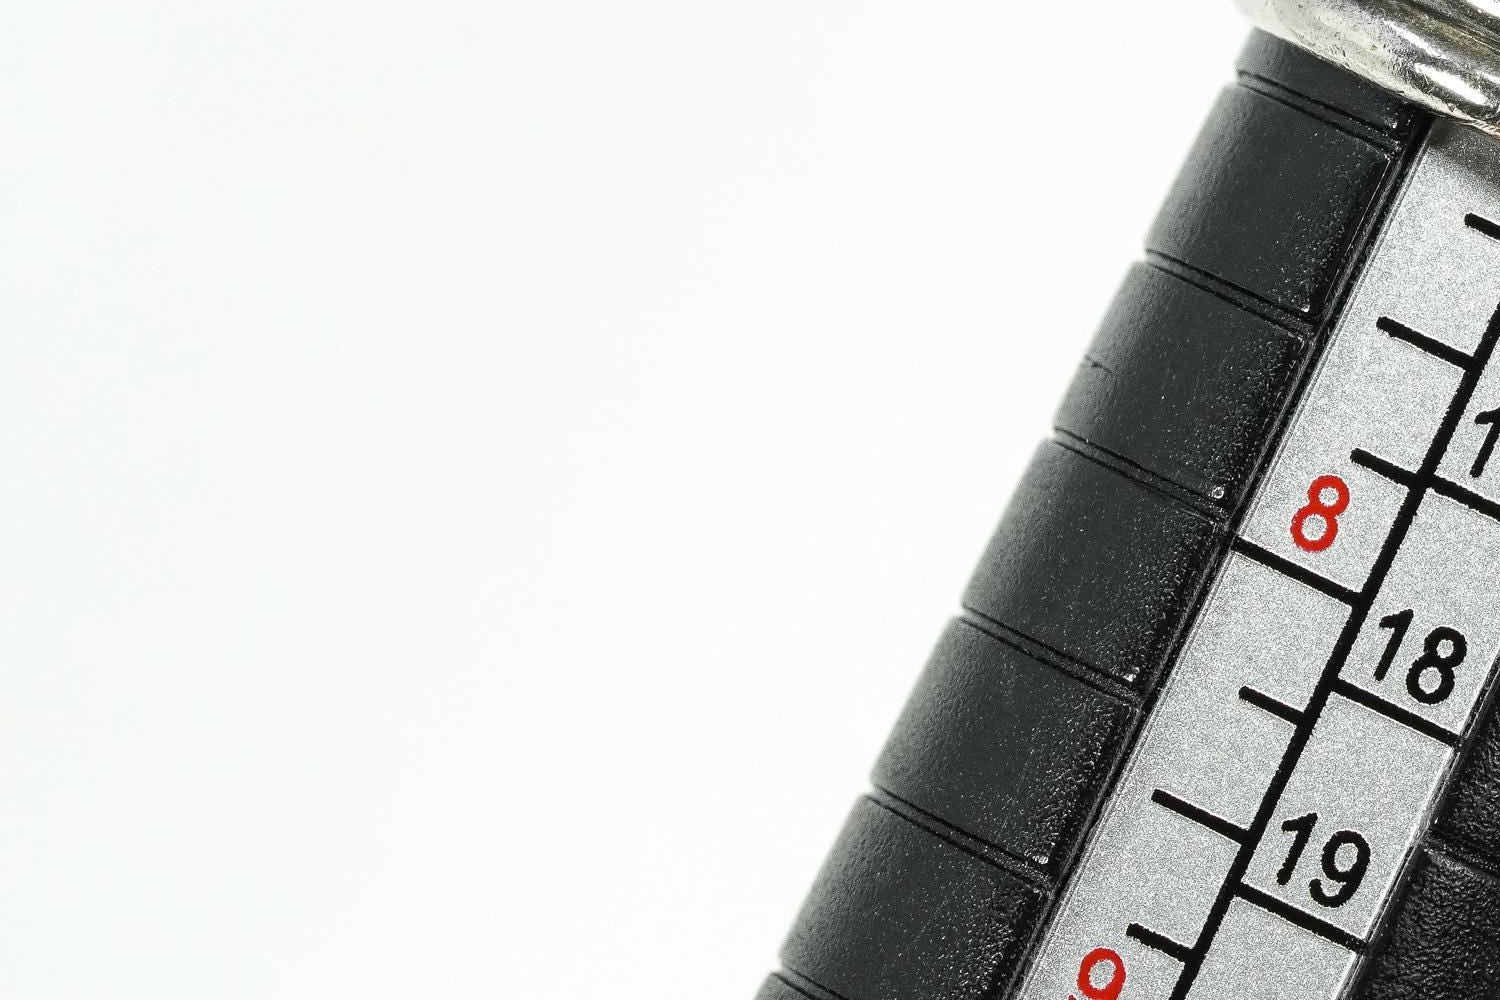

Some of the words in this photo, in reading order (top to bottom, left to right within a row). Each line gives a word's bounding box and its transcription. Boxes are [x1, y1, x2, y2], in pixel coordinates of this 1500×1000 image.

[1289, 474, 1350, 553] 8
[1373, 608, 1468, 706] 18
[1276, 812, 1372, 909] 19
[1067, 947, 1127, 1000] 9
